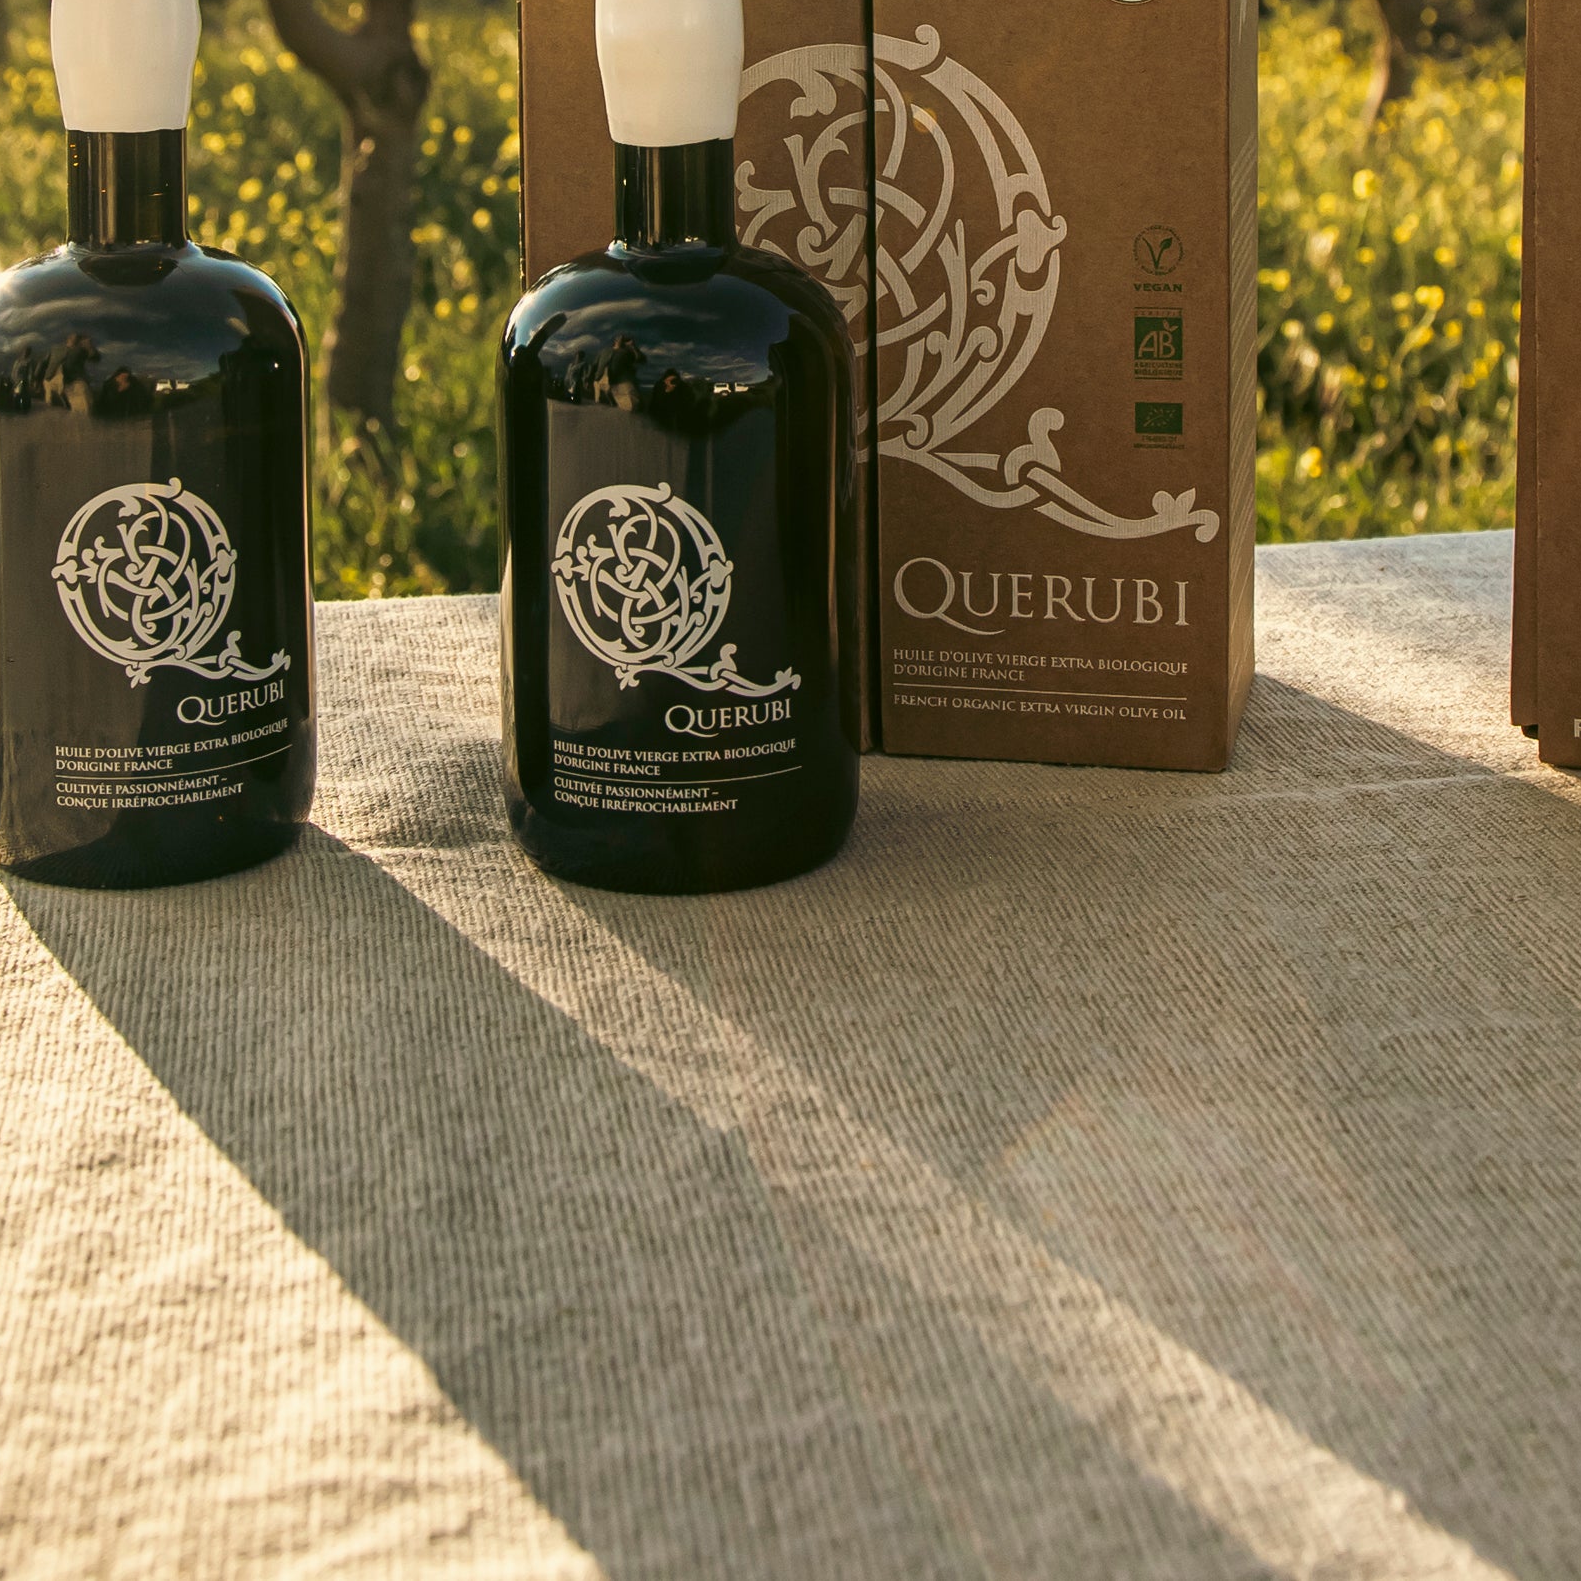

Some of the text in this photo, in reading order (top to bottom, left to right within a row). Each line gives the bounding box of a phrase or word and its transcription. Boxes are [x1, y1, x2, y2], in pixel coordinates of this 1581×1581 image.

[1133, 283, 1183, 293] VEGAN
[1138, 330, 1176, 358] AB
[893, 557, 1190, 636] QUERUBI
[893, 648, 1188, 676] HUILE D'OLIVE VIERGE EXTRA BIOLOGIQUE
[893, 664, 1025, 682] D'ORIGINE FRANCE
[176, 679, 284, 726] QUERUBI
[893, 694, 1187, 721] FRENCH ORGANIC EXTRA VIRGIN OLIVE OIL
[665, 698, 792, 738] QUERUBI
[55, 718, 288, 759] HUILE D'OLIVE VIERGE EXTRA BIOLOGIQUE
[554, 738, 796, 762] HUILE D'OLIVE VIERGE EXTRA BIOLOGIQUE
[55, 759, 173, 772] D'ORIGINE FRANCE
[554, 754, 660, 776] D'ORIGINE FRANCE
[56, 780, 112, 795] CULTIVÉE
[115, 774, 219, 795] PASSIONNÉMENT
[56, 783, 244, 810] CONÇUE IRRÉPROCHABLEMENT
[554, 776, 603, 795] CULTIVÉE
[605, 784, 710, 799] PASSIONNÉMENT
[554, 789, 738, 813] CONÇUE IRRÉPROCHABLEMENT
